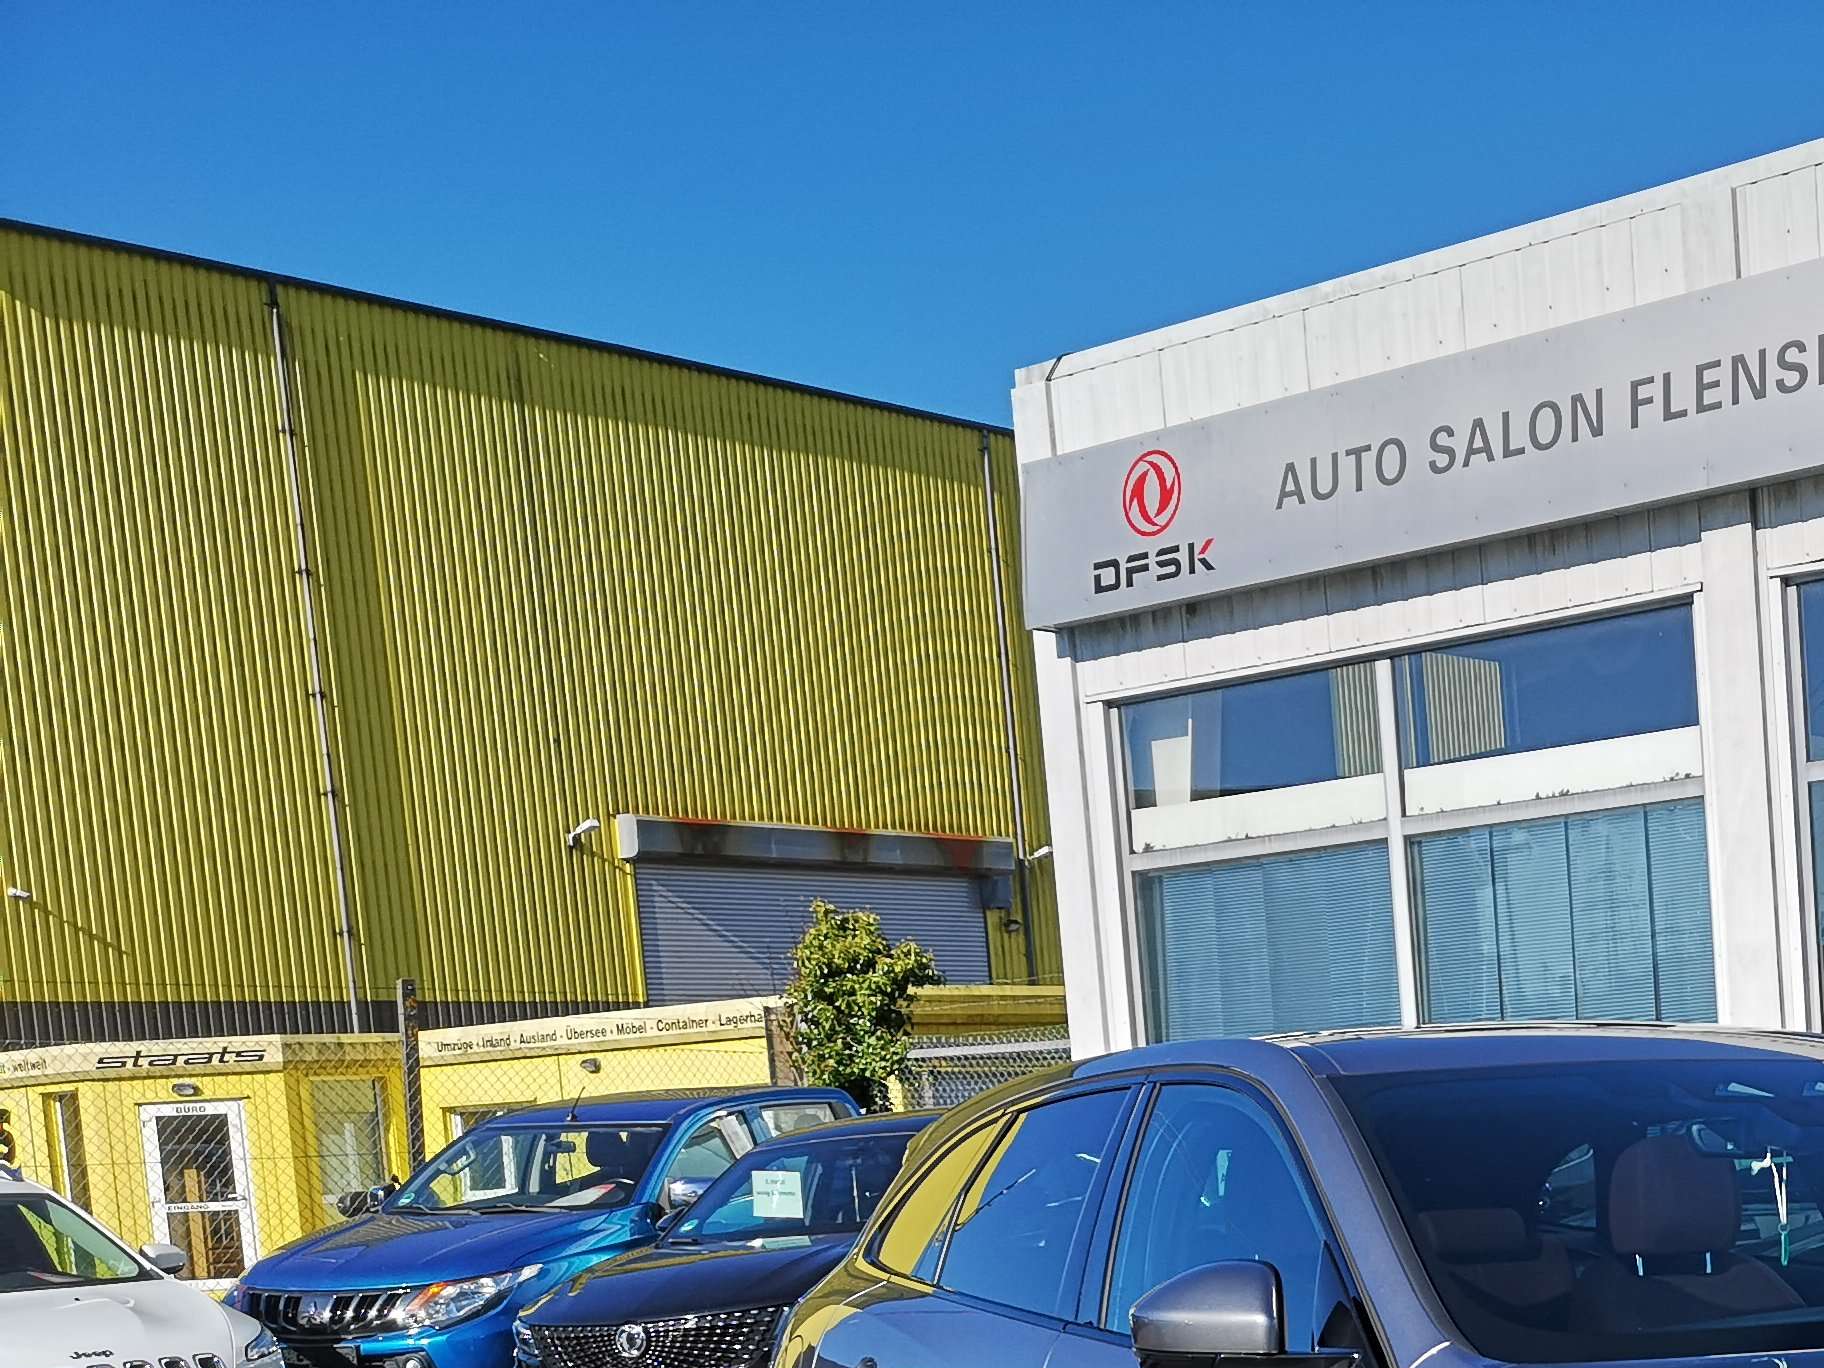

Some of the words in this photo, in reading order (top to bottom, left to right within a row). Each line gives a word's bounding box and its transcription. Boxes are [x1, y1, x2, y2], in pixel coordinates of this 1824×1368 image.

[1275, 437, 1408, 510] AUTO
[1428, 387, 1604, 475] SALON
[1093, 537, 1217, 595] DFSK
[481, 1035, 511, 1050] Inland
[519, 1029, 558, 1045] Ausland
[565, 1025, 607, 1040] Übersee
[616, 1021, 648, 1036] Möbel
[656, 1017, 709, 1033] Container
[96, 1047, 266, 1070] staats
